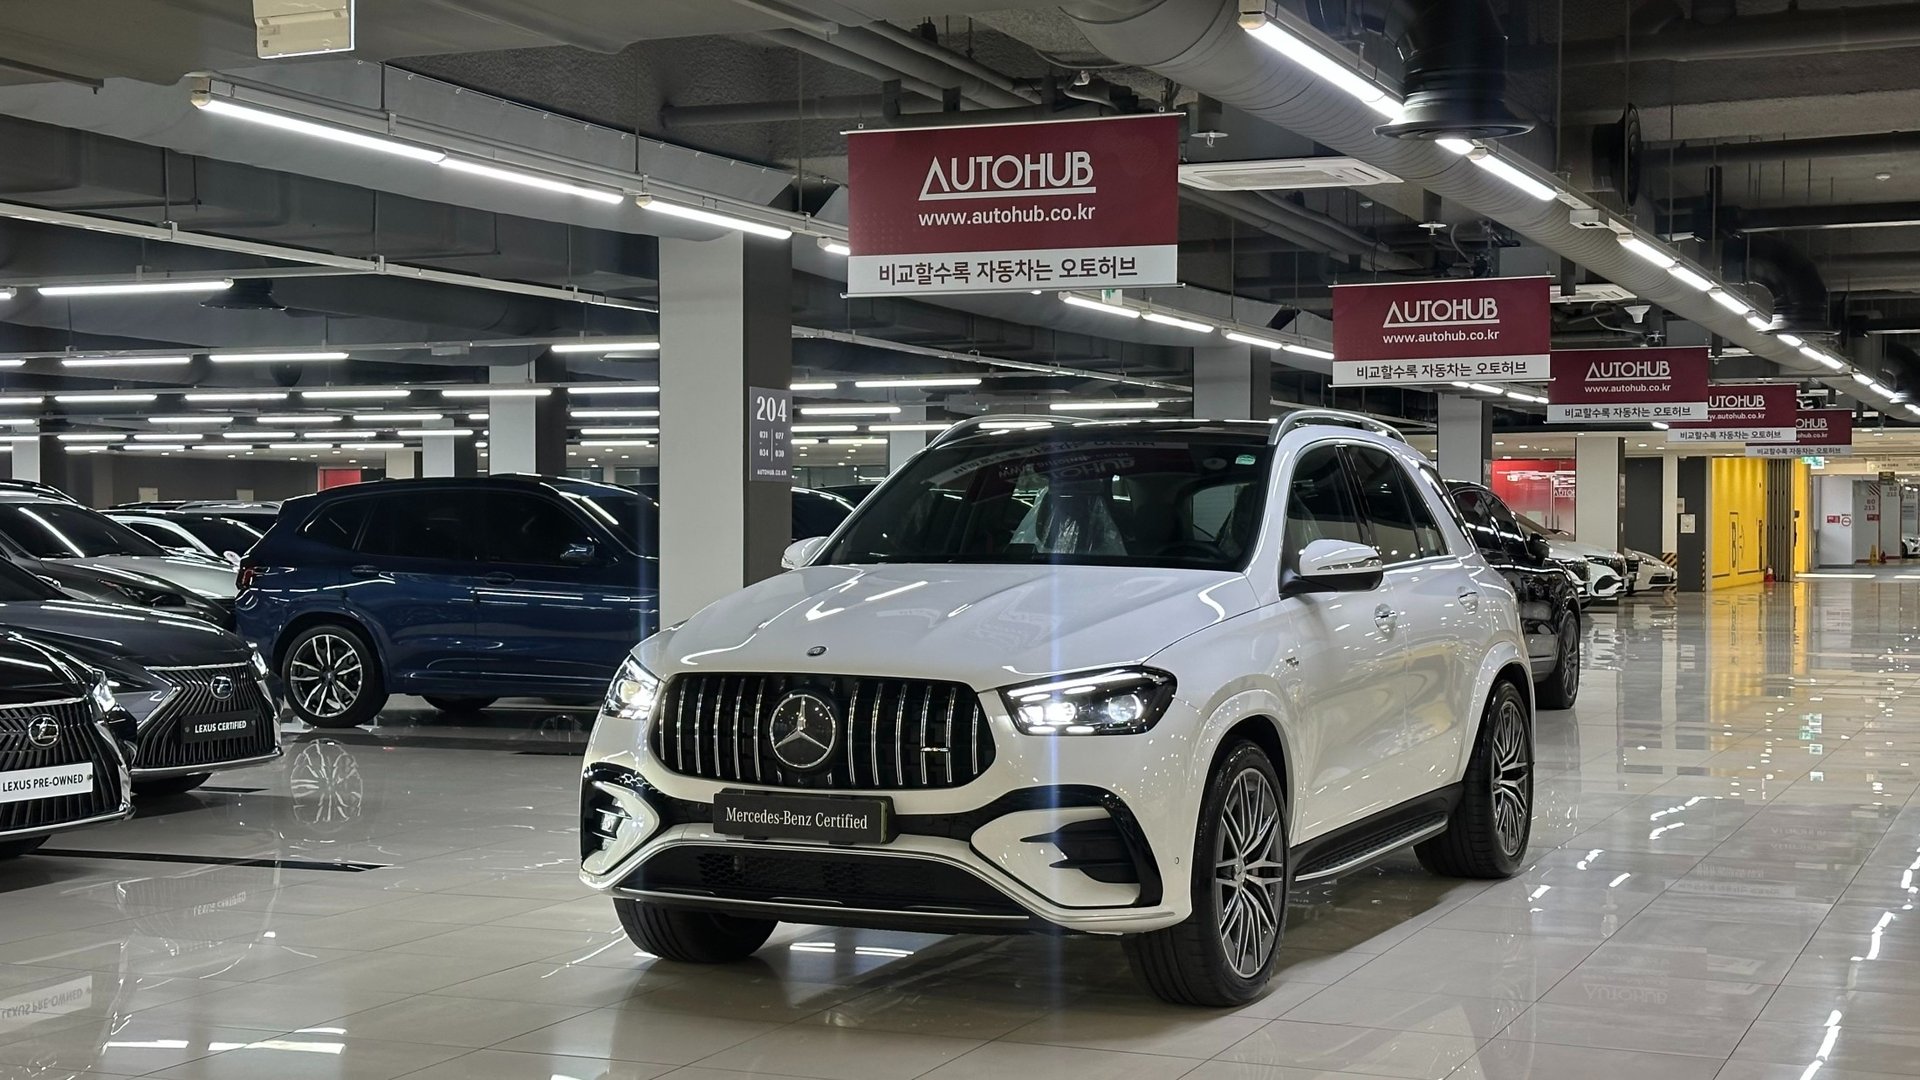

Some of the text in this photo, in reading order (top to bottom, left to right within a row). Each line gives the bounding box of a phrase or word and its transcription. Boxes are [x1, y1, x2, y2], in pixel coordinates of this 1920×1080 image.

[918, 151, 1096, 201] AUTOHUB
[918, 203, 1095, 226] www.autohub.co.kr
[878, 256, 1138, 286] 비교할수록 자동차는 오토허브
[1383, 297, 1500, 328] AUTOHUB
[1383, 329, 1500, 344] www.autohub.co.kr
[1356, 361, 1527, 380] 비교할수록 자동차는 오토허브
[1584, 361, 1672, 381] AUTOHUB
[1584, 383, 1671, 393] www.autohub.co.kr
[756, 395, 787, 422] 204
[1708, 395, 1766, 410] UTOHUB
[1565, 406, 1692, 419] 비교할수록 자동차는 오토허브
[1796, 418, 1828, 431] OHUB
[194, 720, 247, 734] LEXUS CERTIFIED
[2, 774, 84, 793] LEXUS PRE-OWNED
[725, 806, 868, 830] Mercedes-Benz Certified
